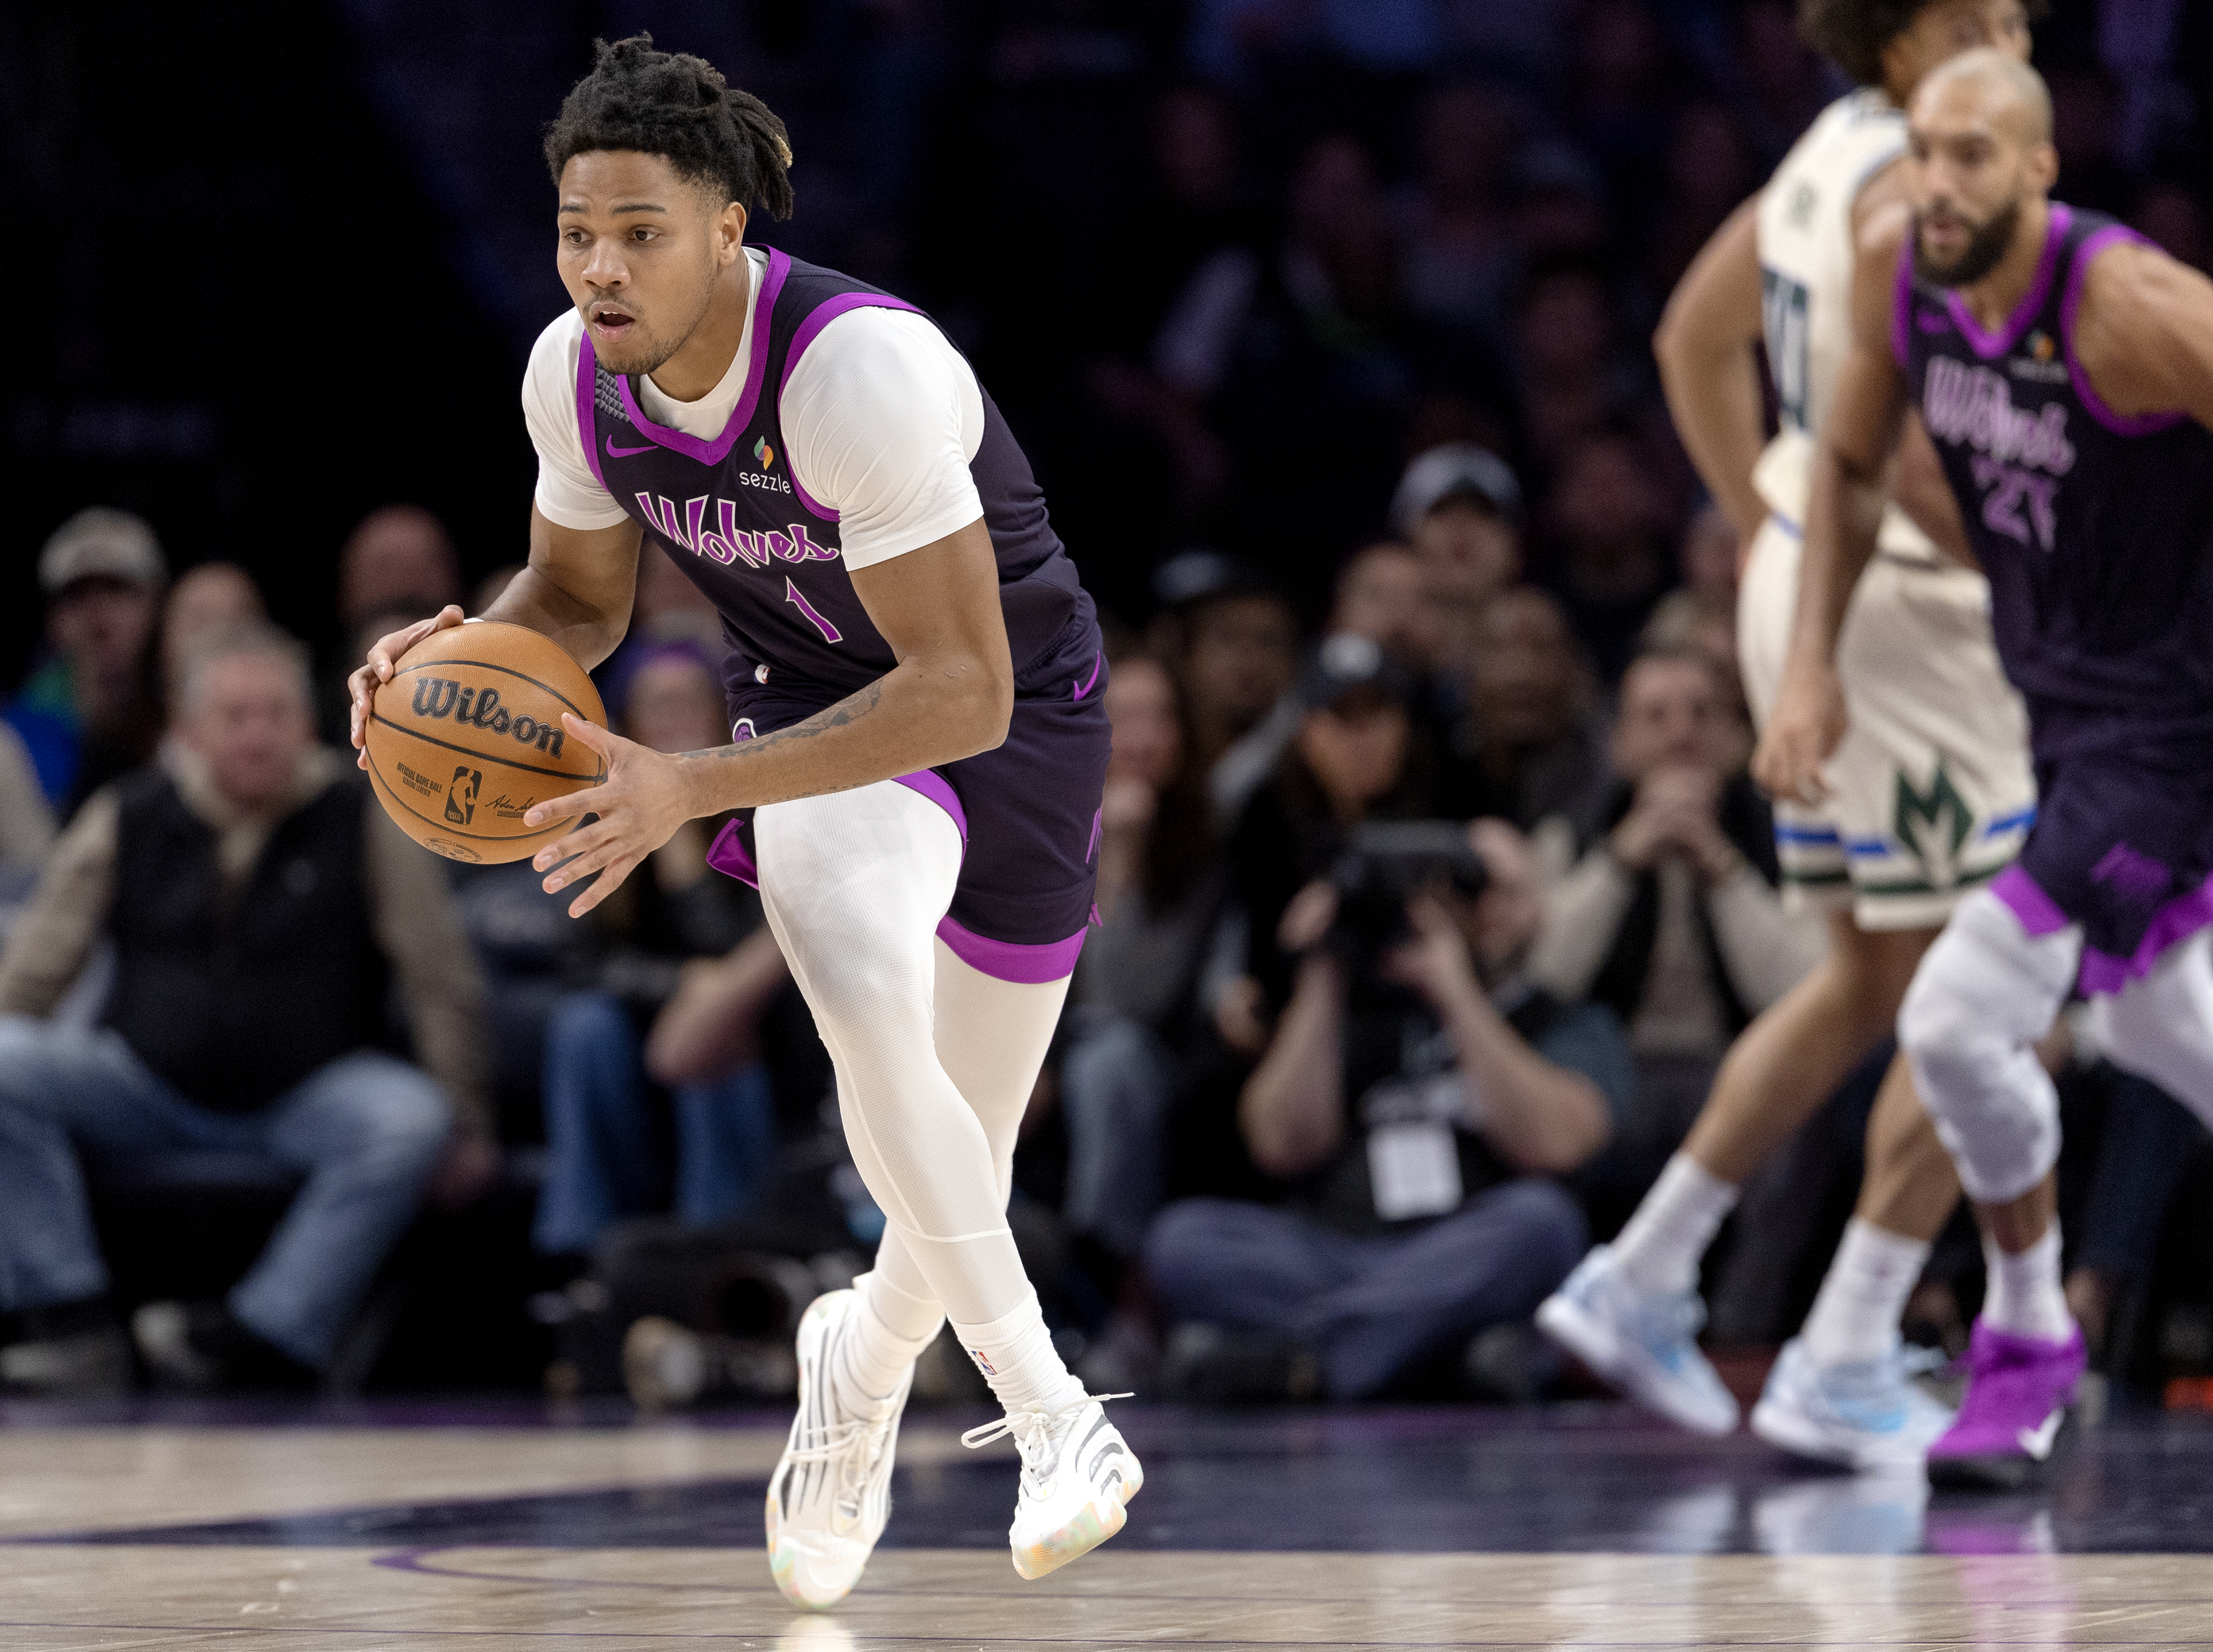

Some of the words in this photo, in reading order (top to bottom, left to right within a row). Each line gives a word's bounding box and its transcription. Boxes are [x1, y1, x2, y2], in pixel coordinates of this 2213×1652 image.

[739, 471, 790, 494] sezzle
[635, 491, 839, 568] Wolves
[786, 575, 843, 644] 1
[412, 676, 565, 760] Wilson
[397, 761, 416, 781] OFFICIAL
[429, 780, 443, 794] BALL
[447, 810, 462, 822] NBA
